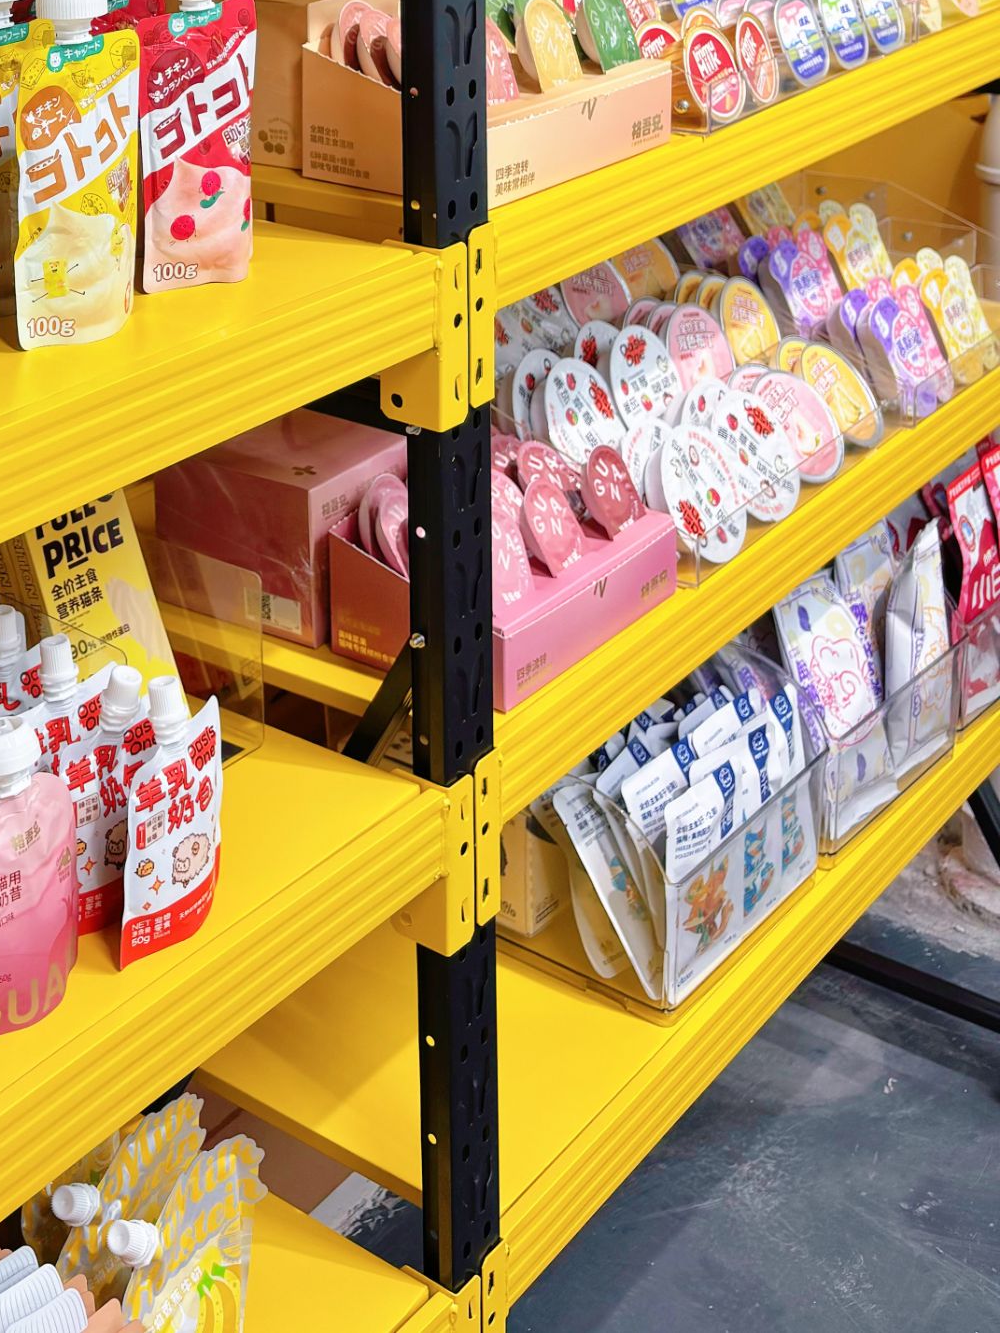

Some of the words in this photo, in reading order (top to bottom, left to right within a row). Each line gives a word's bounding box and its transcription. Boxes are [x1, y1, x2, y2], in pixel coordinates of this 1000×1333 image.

[163, 57, 190, 80] チキン
[495, 158, 530, 180] 四季流转
[152, 261, 198, 283] 100g
[26, 315, 76, 338] 100g
[42, 517, 125, 580] PRICE
[51, 568, 99, 602] 全价主食
[56, 586, 104, 620] 营养猫条
[66, 745, 119, 794] 羊乳
[195, 743, 216, 772] One
[135, 757, 195, 813] 羊乳
[168, 775, 214, 835] 奶包
[131, 920, 150, 931] NET
[131, 936, 150, 947] 50g
